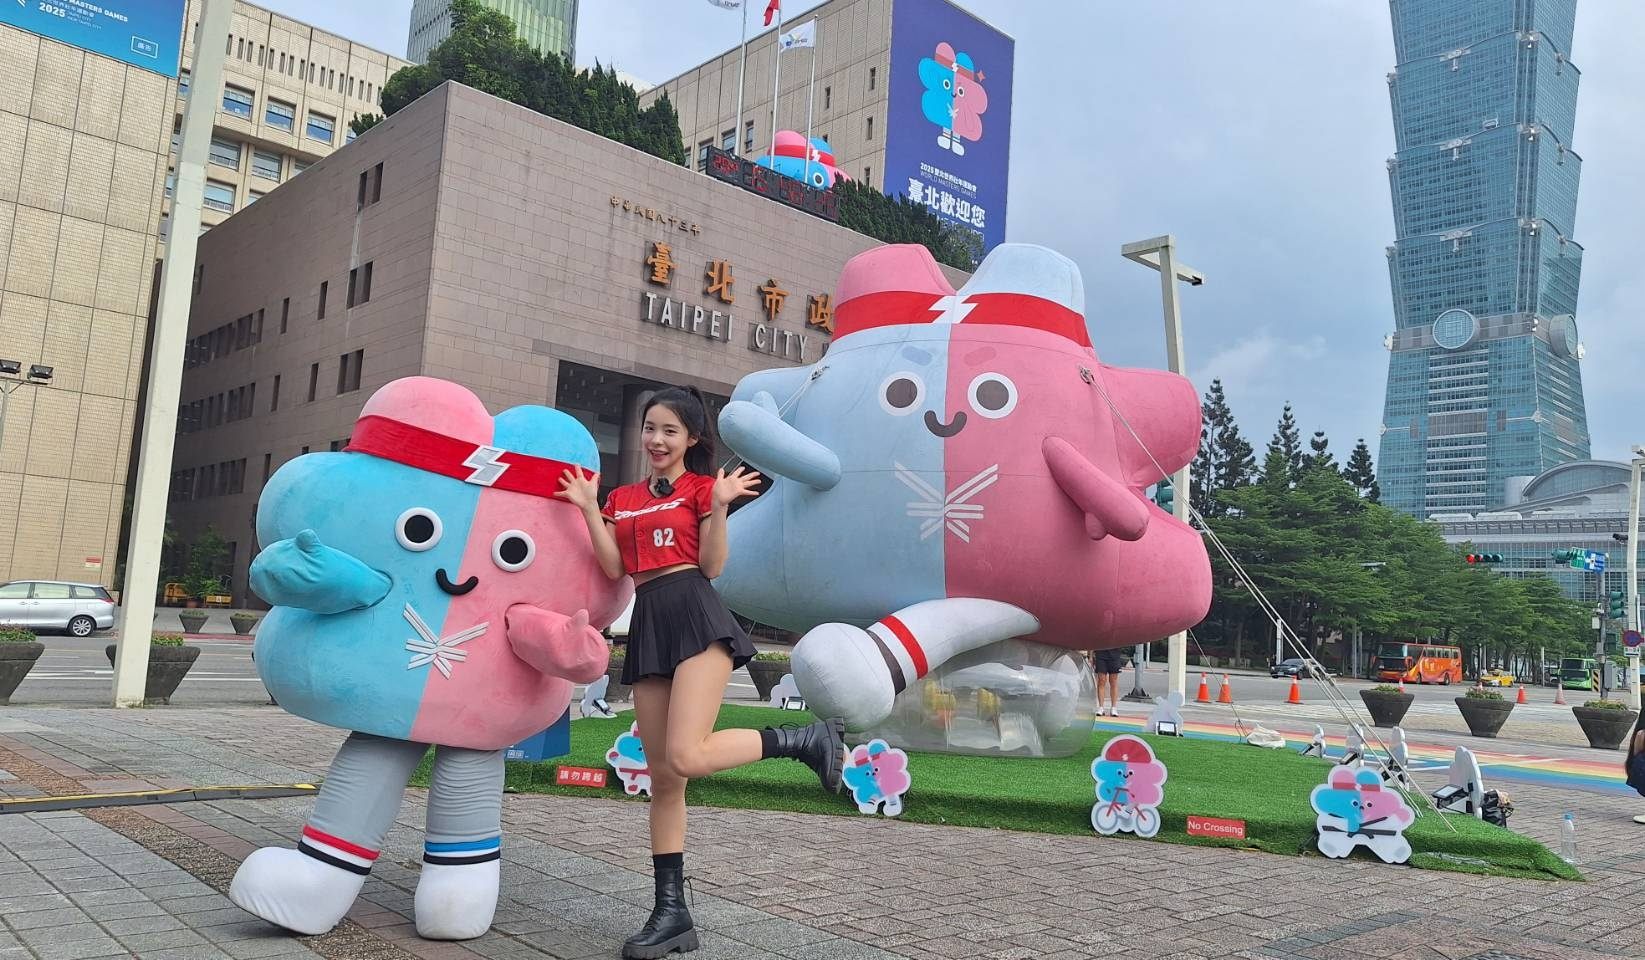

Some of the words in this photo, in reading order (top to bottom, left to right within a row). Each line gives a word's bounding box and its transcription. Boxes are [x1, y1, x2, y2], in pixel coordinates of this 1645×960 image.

[39, 2, 66, 18] 2025
[104, 10, 129, 22] GAMES
[908, 177, 985, 228] 臺北歡迎您
[645, 291, 733, 342] TAIPEI
[754, 323, 808, 361] CITY
[653, 527, 675, 548] 82
[1188, 820, 1201, 830] No
[1203, 822, 1243, 836] Crossing
